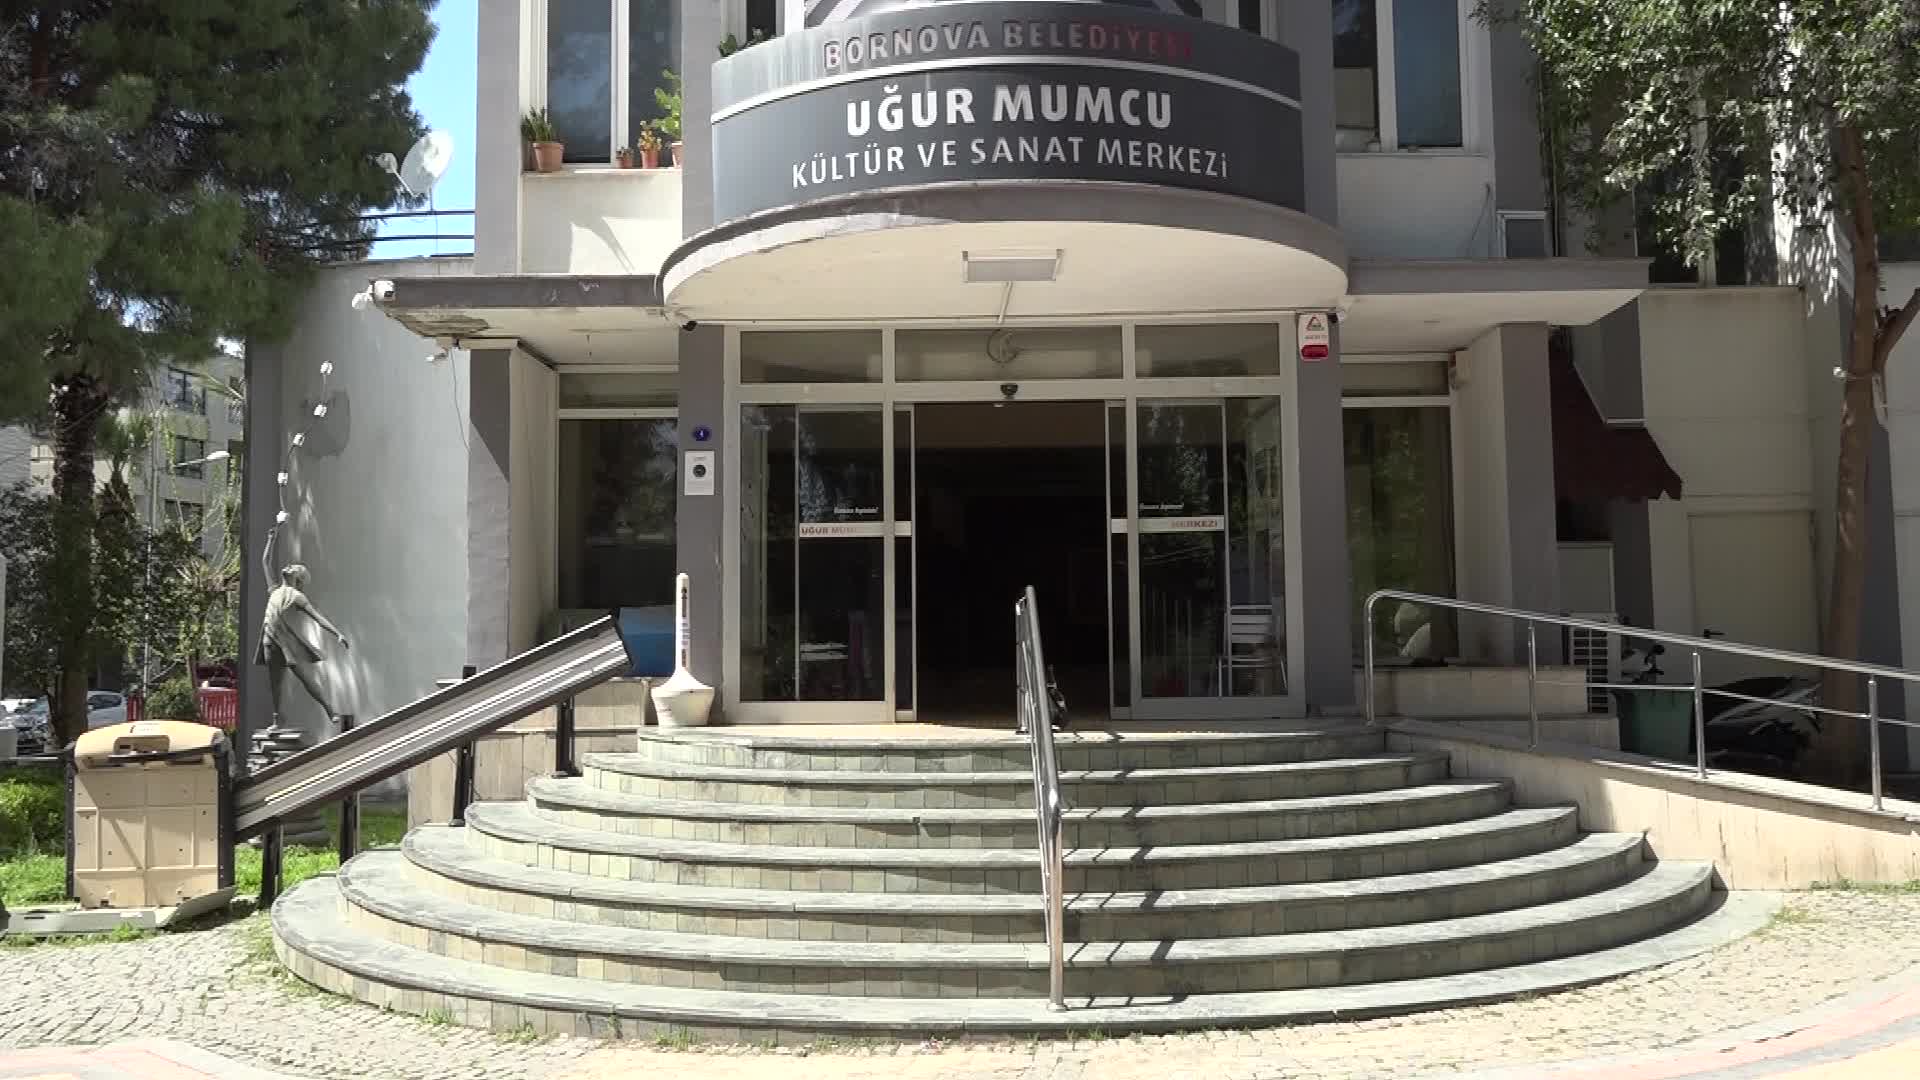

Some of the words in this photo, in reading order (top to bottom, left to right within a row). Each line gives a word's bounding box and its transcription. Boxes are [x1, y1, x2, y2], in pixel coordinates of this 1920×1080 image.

[824, 21, 991, 68] BORNOVA
[847, 84, 976, 136] UĞUR
[992, 84, 1171, 129] MUMCU
[792, 142, 905, 189] KÜLTÜR
[917, 140, 957, 168] VE
[970, 136, 1084, 165] SANAT
